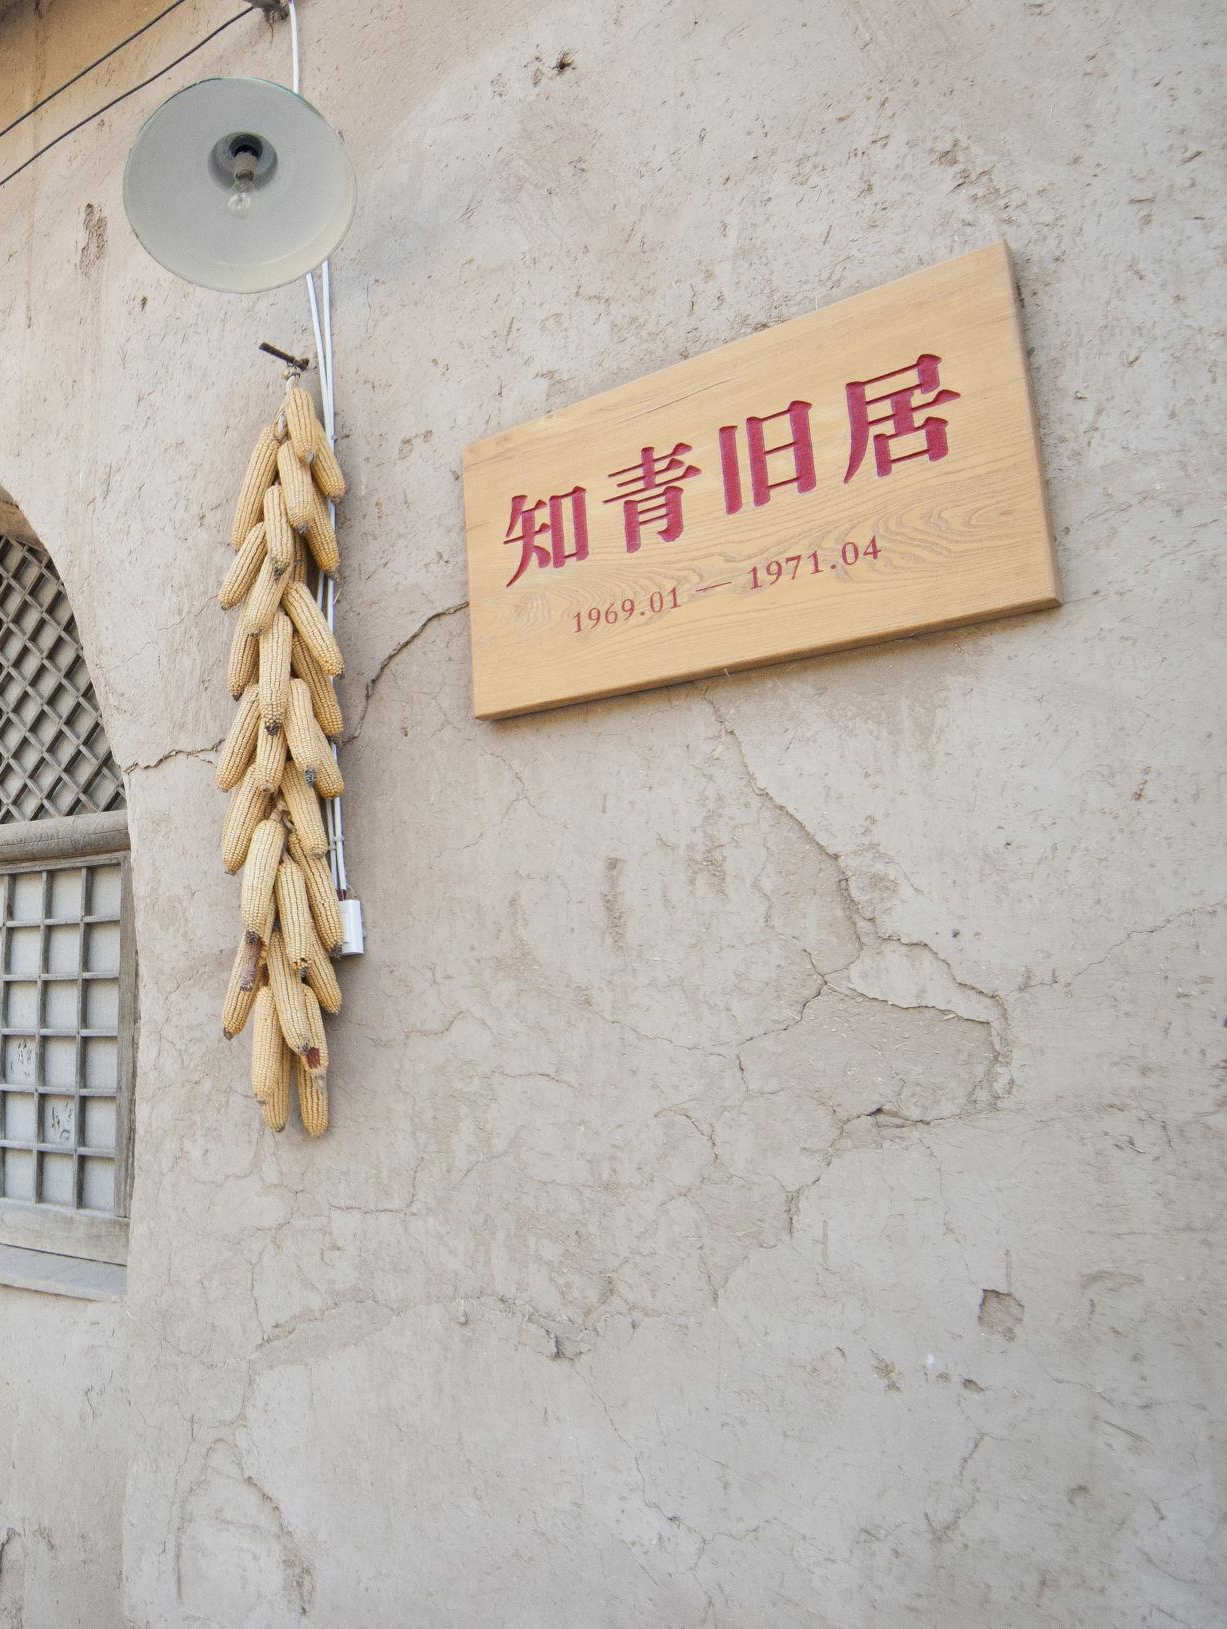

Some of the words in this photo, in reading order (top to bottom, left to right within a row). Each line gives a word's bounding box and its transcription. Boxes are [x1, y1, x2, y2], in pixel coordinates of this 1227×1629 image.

[502, 353, 962, 588] 知青旧居
[572, 585, 683, 634] 1969.01
[748, 535, 883, 591] 1971.04
